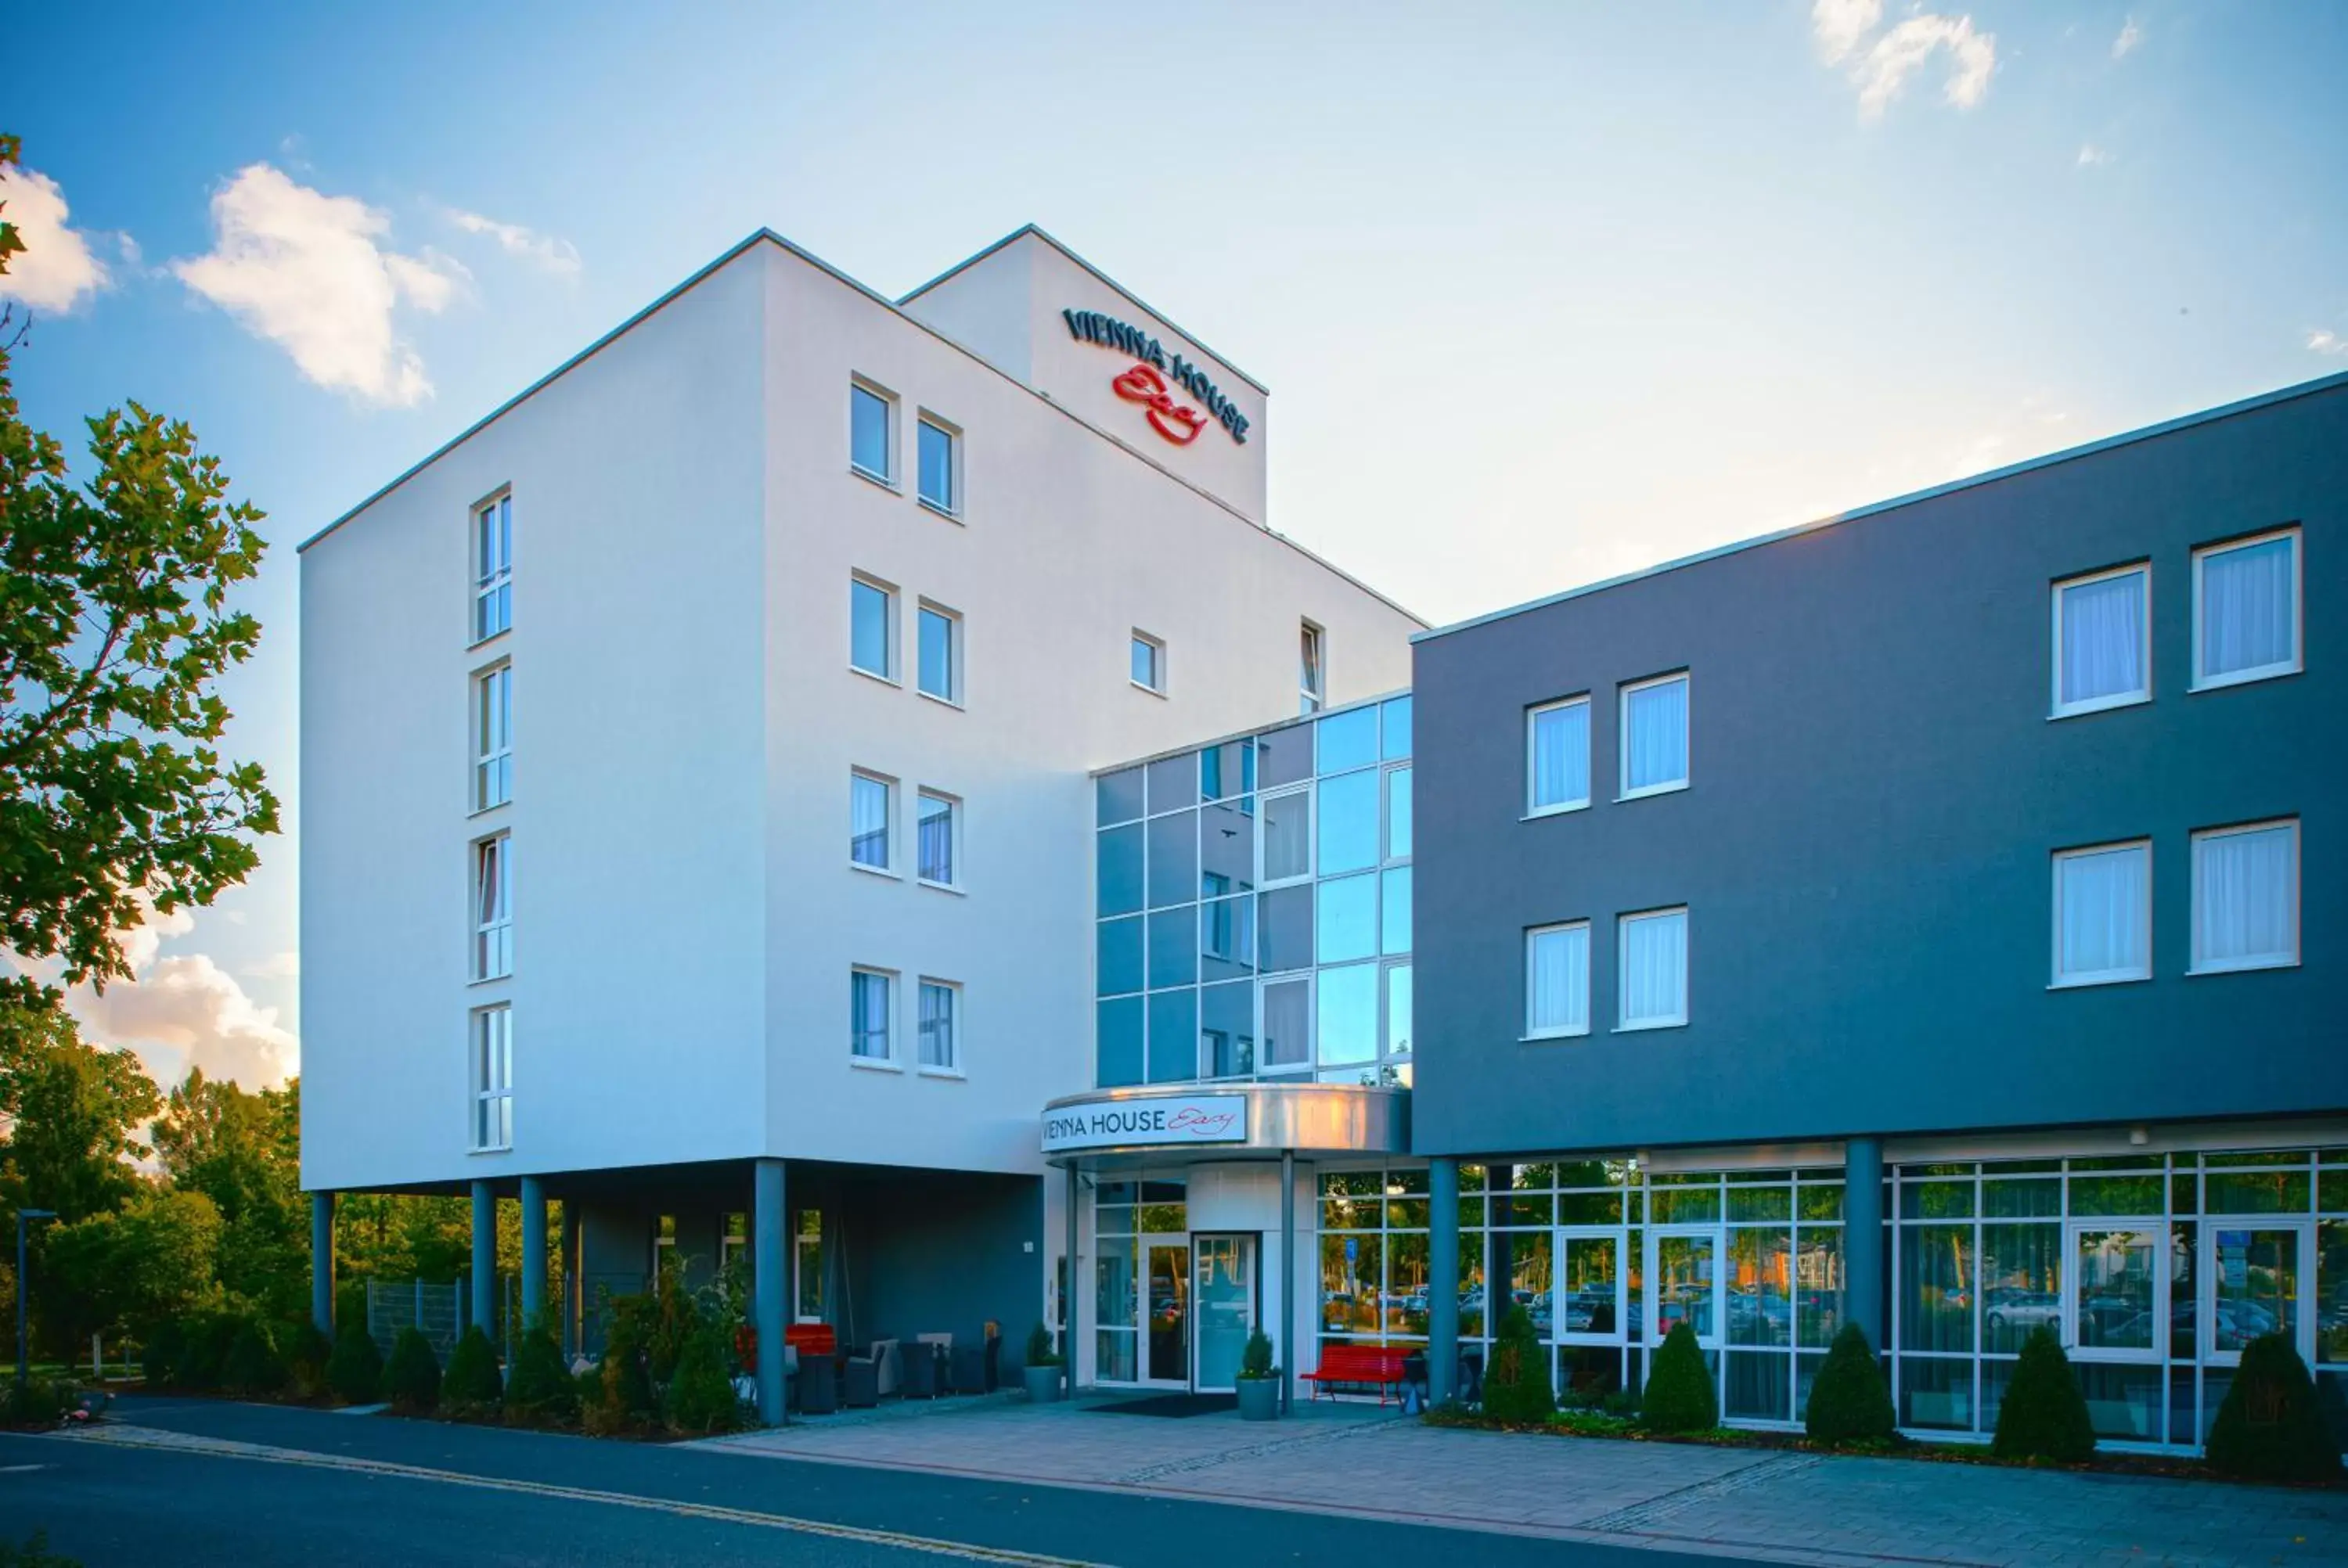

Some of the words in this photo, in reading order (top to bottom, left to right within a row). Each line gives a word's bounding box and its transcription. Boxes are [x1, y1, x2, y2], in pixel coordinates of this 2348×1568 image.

[1062, 308, 1166, 370] VIENNA
[1173, 353, 1250, 444] HOUSE
[1112, 363, 1208, 445] Easy
[1092, 1110, 1165, 1135] HOUSE
[1168, 1107, 1237, 1135] Easy
